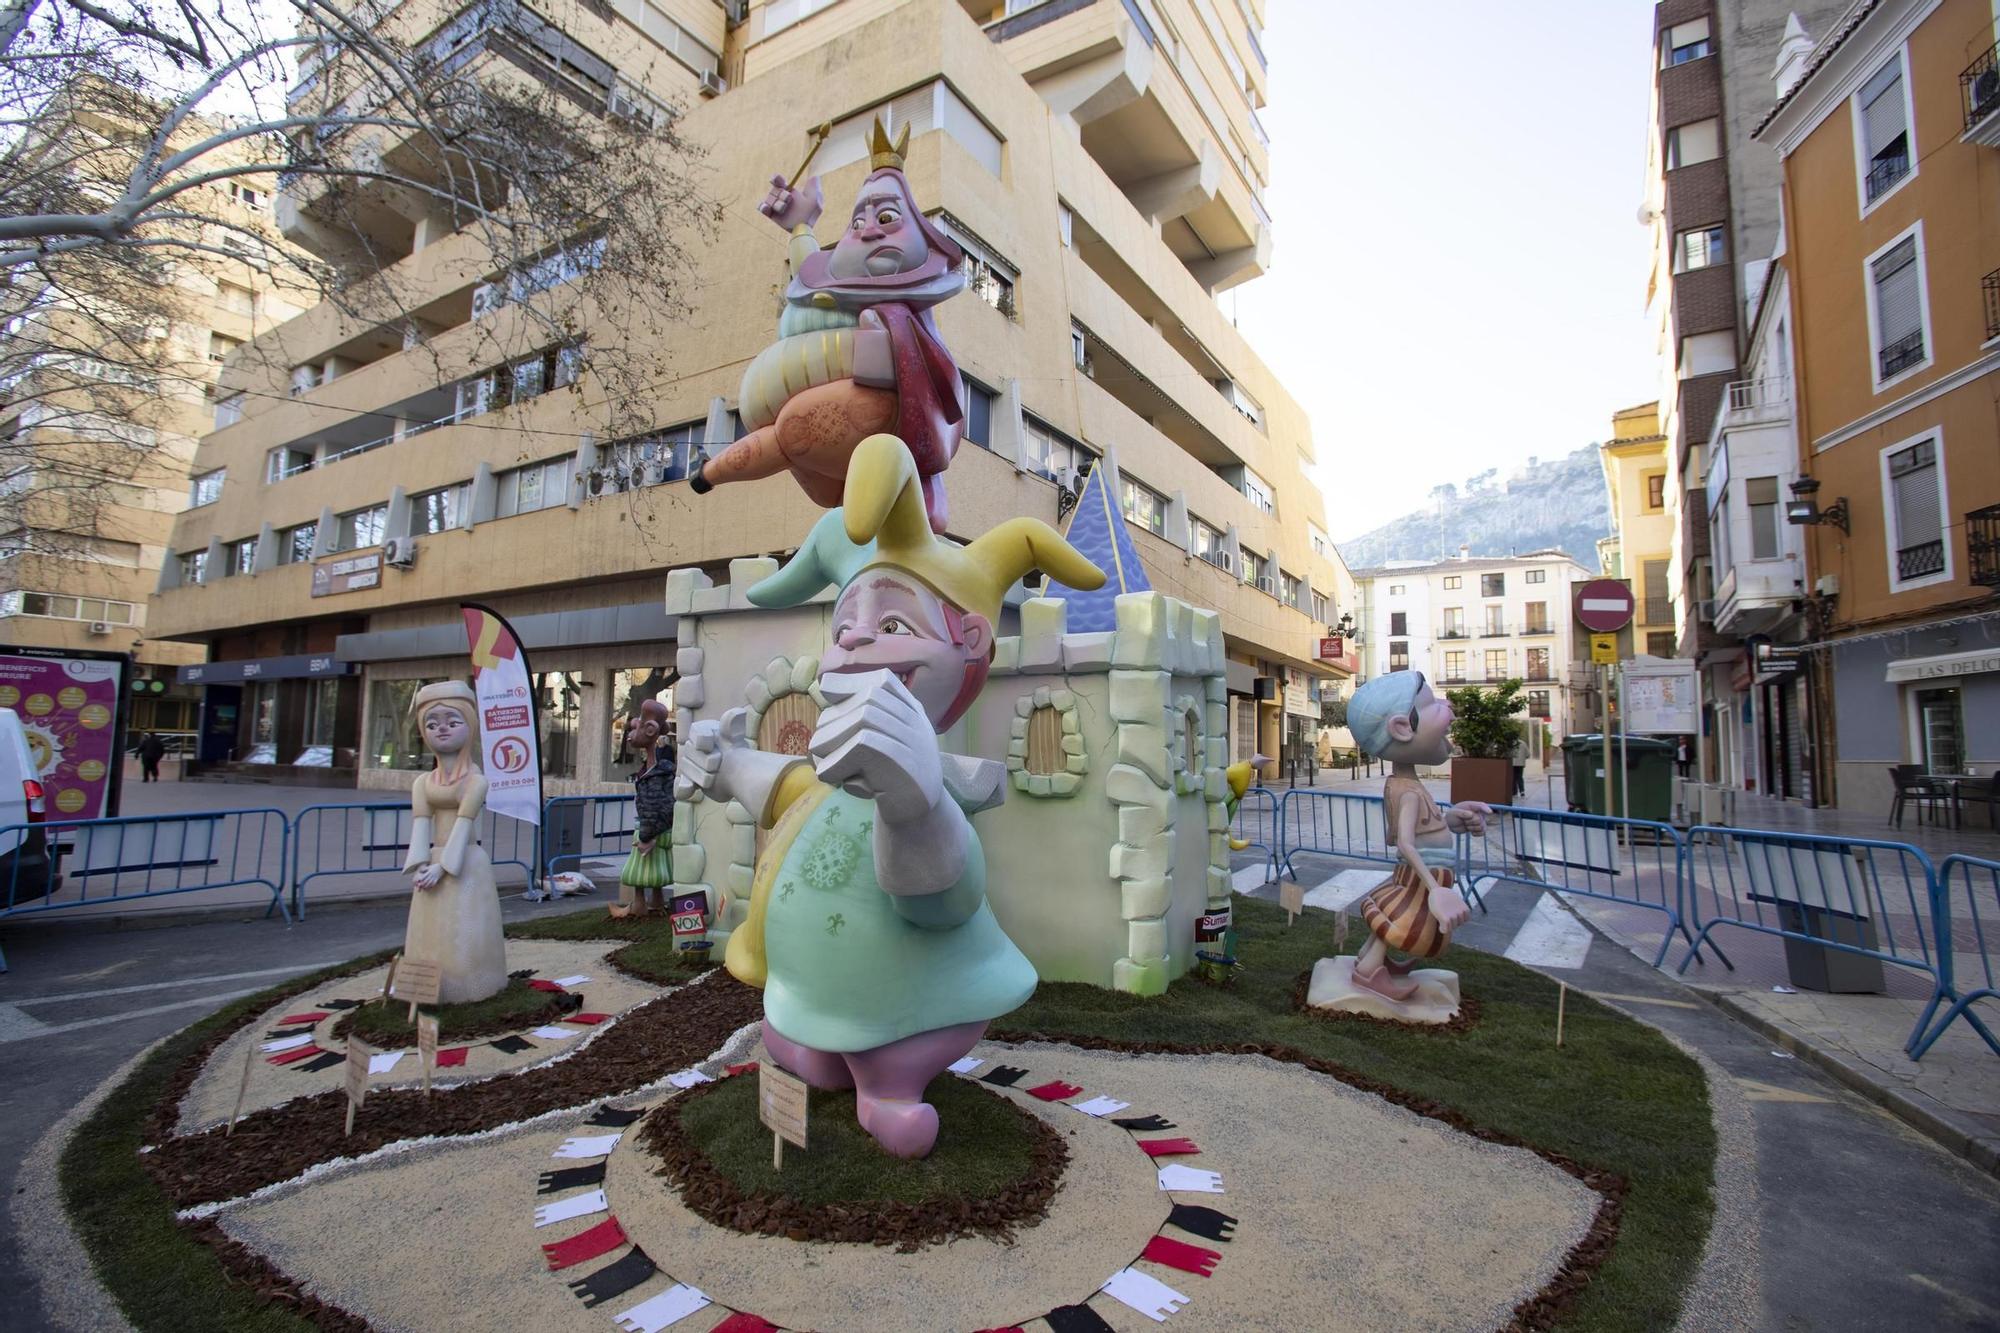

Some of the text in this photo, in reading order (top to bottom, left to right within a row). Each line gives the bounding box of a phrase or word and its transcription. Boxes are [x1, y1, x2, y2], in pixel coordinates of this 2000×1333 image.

[244, 664, 261, 676] BBVA
[310, 658, 330, 671] BBVA
[188, 668, 202, 679] BBVA
[1917, 665, 1944, 678] LAS
[675, 916, 701, 929] VOX
